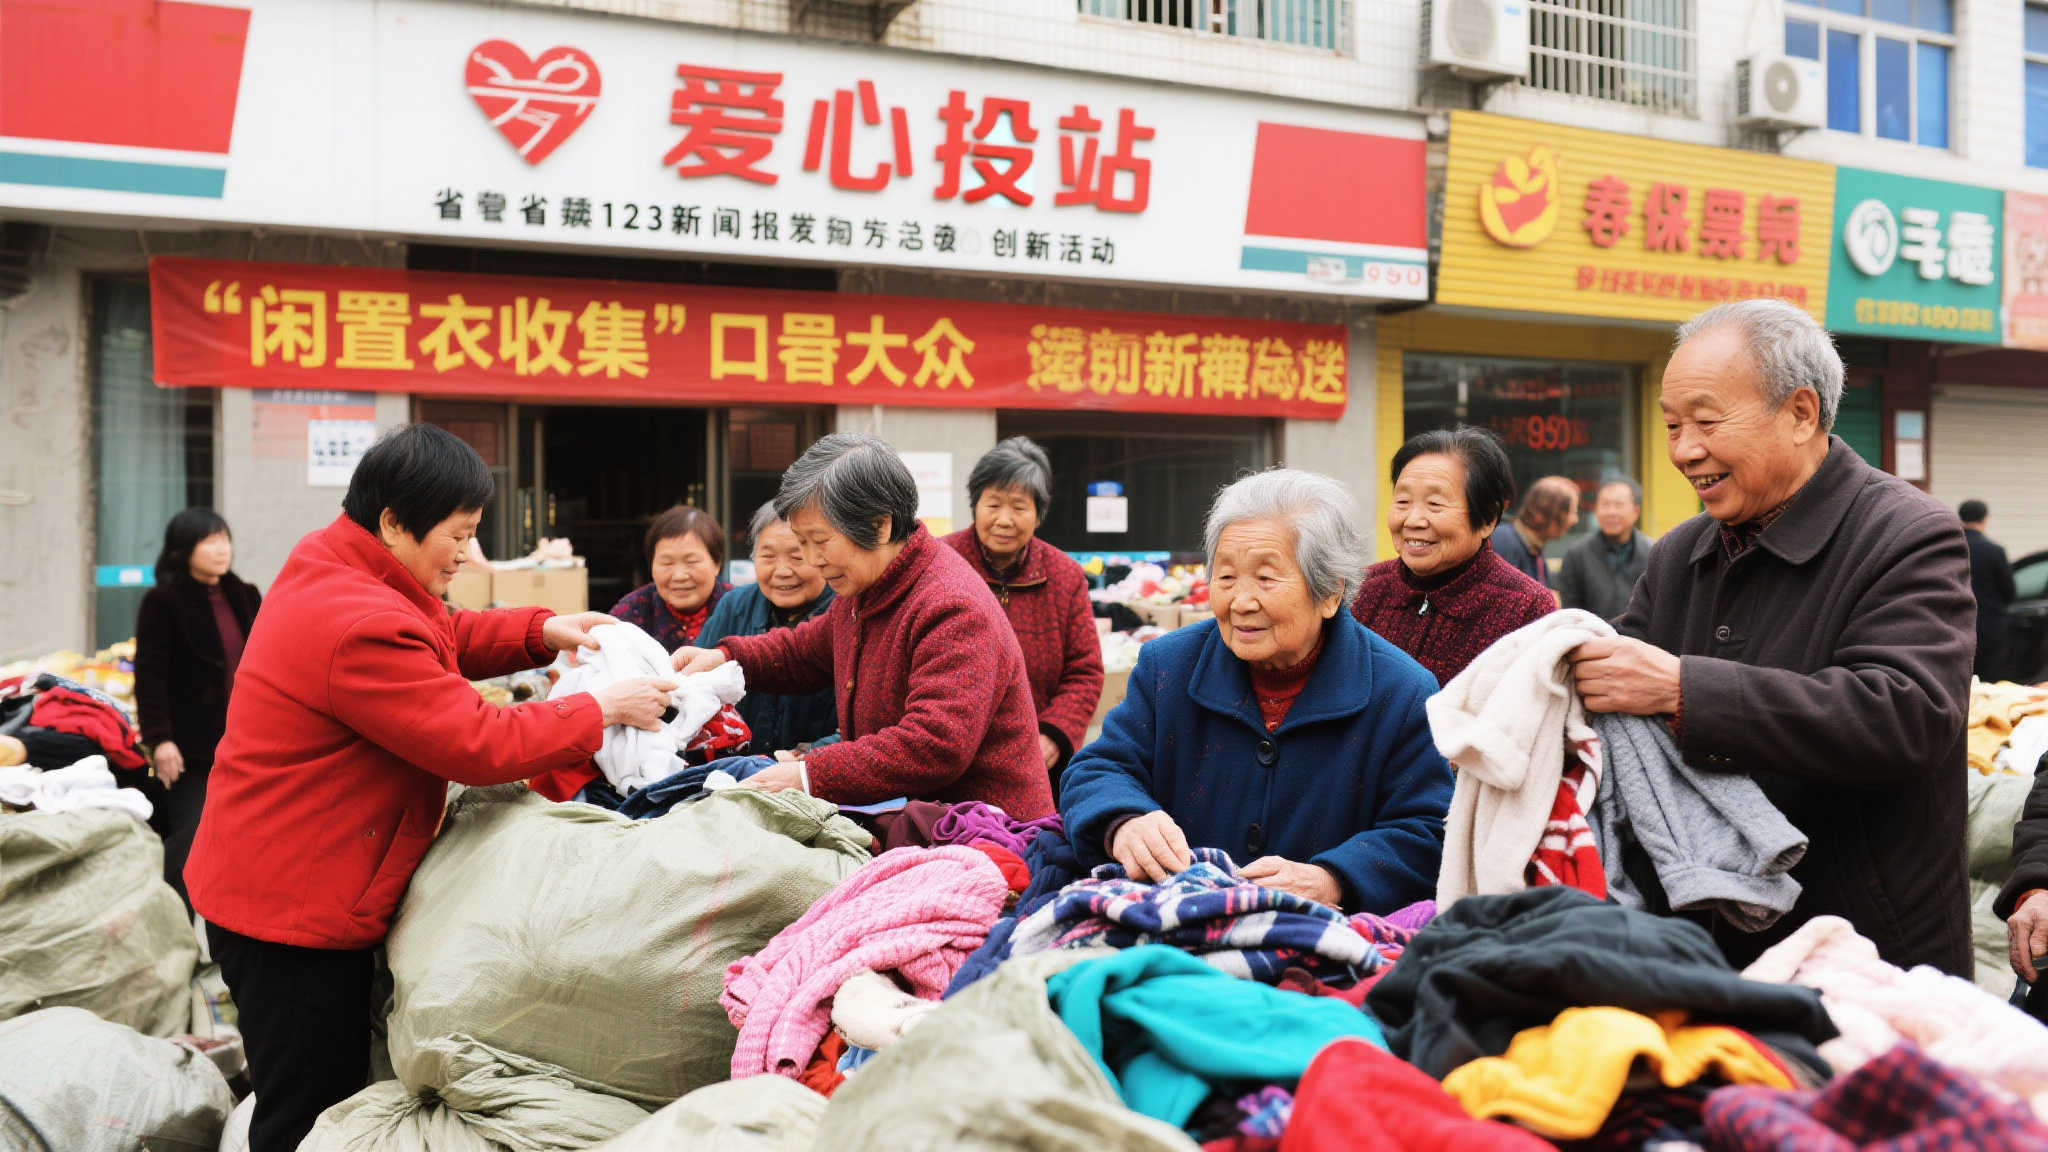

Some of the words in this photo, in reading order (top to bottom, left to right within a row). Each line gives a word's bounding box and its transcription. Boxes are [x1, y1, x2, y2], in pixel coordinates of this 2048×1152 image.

[662, 63, 1156, 214] 爱心投站
[992, 228, 1116, 265] 创新活动
